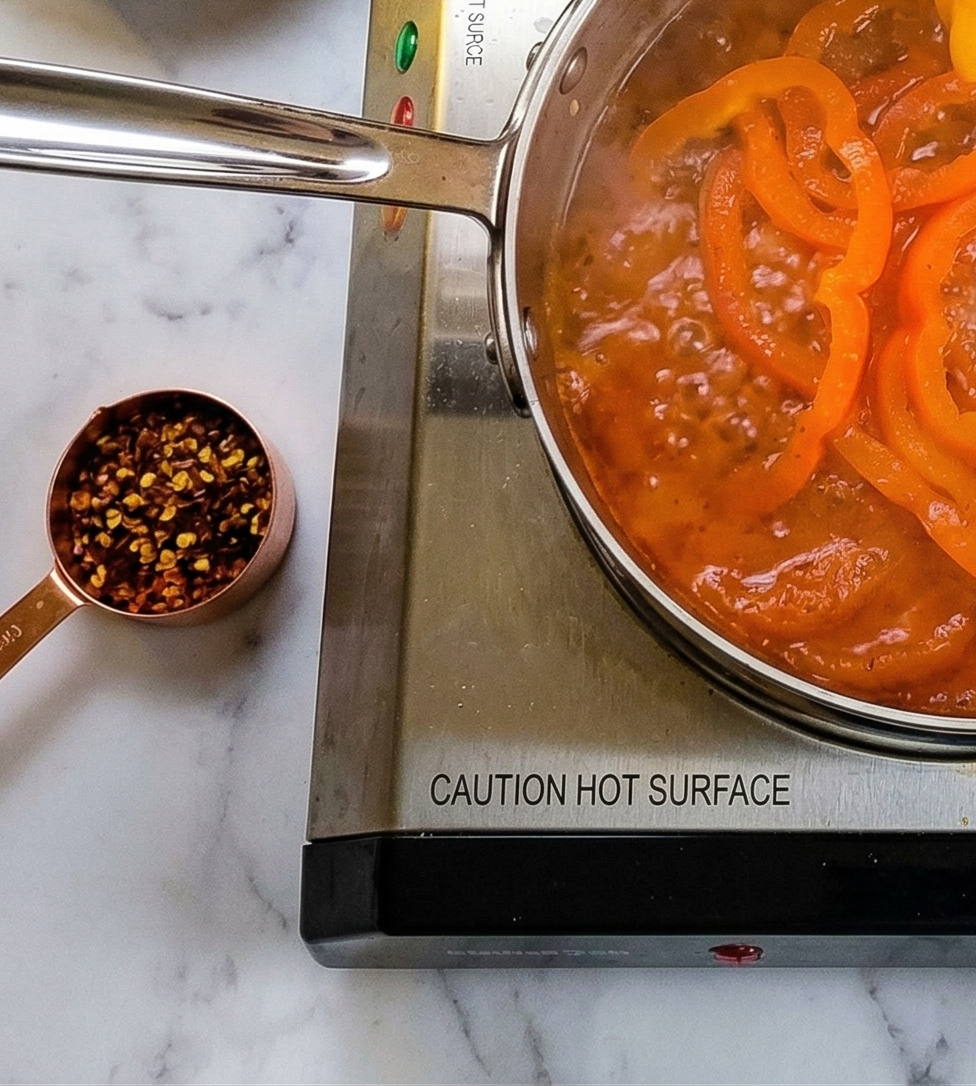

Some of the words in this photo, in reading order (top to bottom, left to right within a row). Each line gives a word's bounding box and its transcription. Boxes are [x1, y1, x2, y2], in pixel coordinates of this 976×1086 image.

[465, 12, 485, 66] SURCE
[430, 773, 566, 806] CAUTION
[577, 773, 640, 806] HOT
[648, 773, 791, 806] SURFACE
